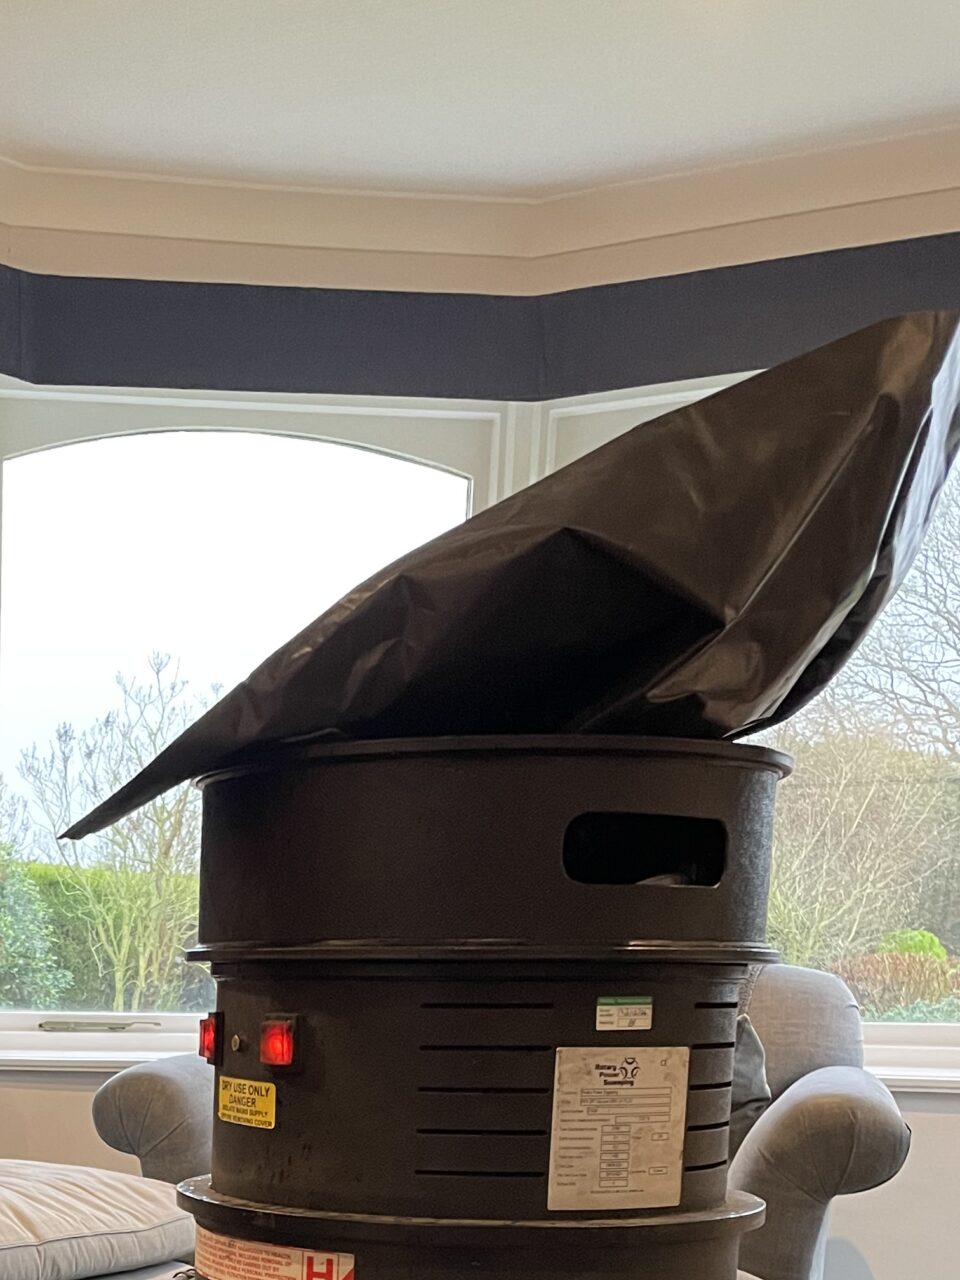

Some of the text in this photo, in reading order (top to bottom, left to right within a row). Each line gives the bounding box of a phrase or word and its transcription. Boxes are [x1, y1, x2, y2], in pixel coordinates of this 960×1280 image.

[233, 1082, 247, 1094] USE
[248, 1085, 270, 1098] ONLY
[229, 1094, 257, 1108] DANGER
